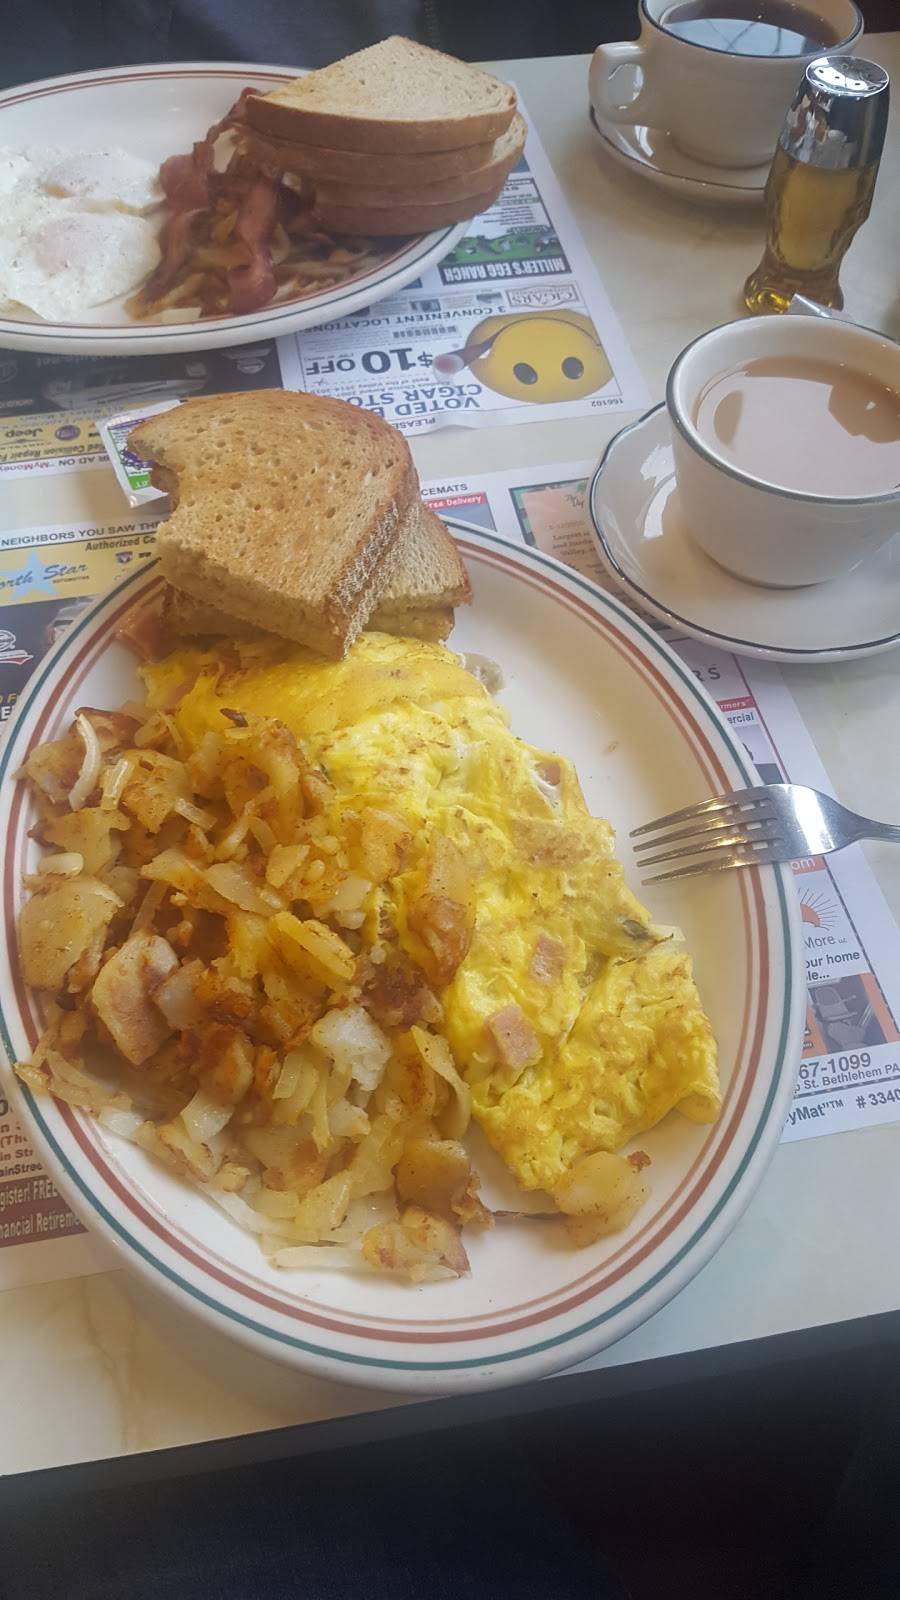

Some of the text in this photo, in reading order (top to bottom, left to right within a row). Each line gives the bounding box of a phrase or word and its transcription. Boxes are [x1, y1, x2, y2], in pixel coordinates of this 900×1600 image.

[443, 257, 566, 282] MILLER'S EGG RANCH
[511, 290, 573, 305] CIGARS
[395, 307, 493, 325] CONVENIENT
[306, 347, 434, 376] $10 OFF
[403, 384, 483, 402] CIGAR
[394, 397, 481, 417] VOTED
[4, 428, 44, 440] Jeep
[58, 458, 76, 467] ON
[78, 456, 96, 465] AD
[0, 531, 76, 547] NEIGHBORS
[78, 527, 105, 537] YOU
[108, 524, 136, 534] SAW
[85, 537, 141, 551] Authorized
[43, 563, 89, 580] Star
[826, 951, 861, 965] home
[803, 1063, 900, 1090] St. Bethlehem PA
